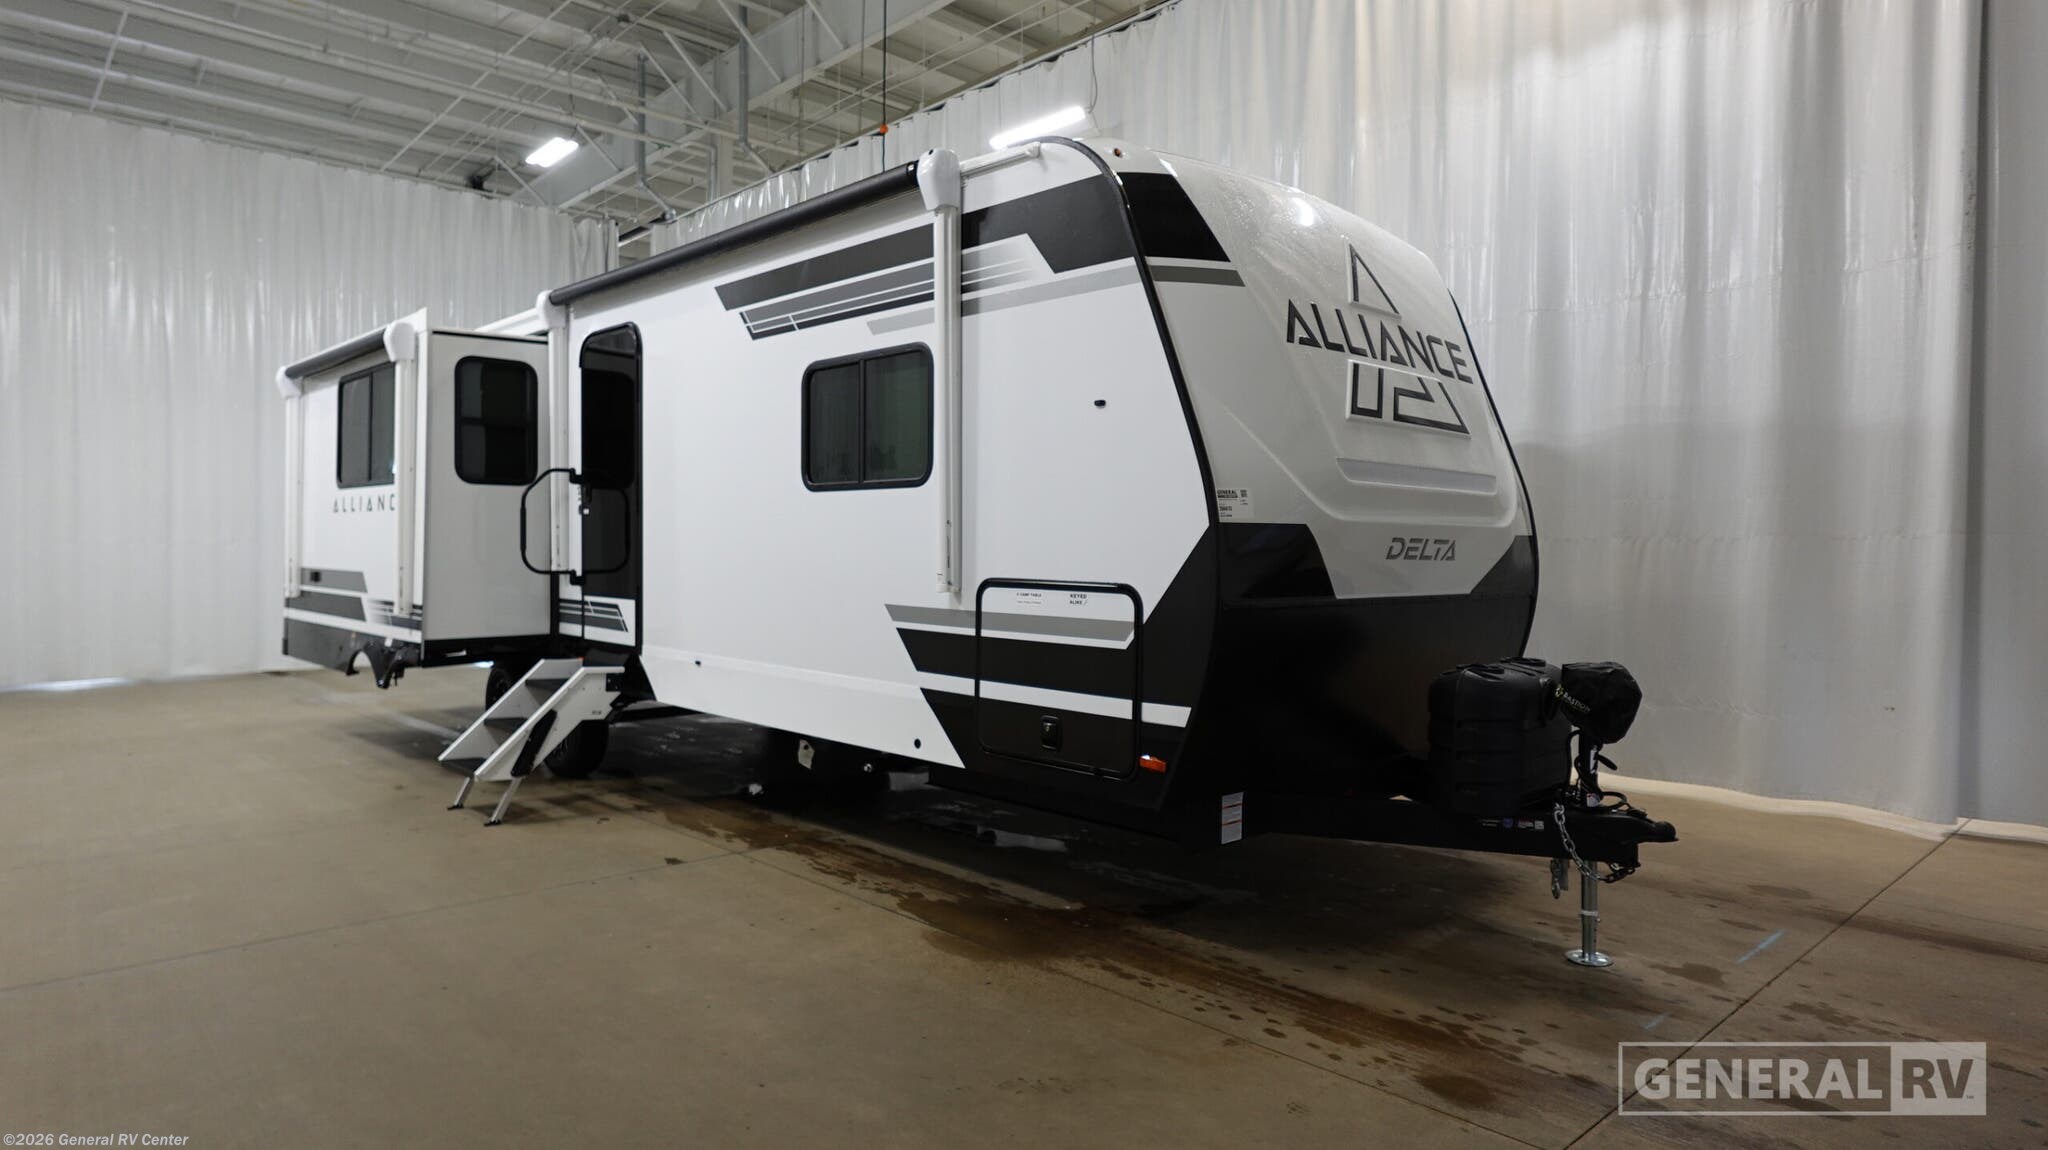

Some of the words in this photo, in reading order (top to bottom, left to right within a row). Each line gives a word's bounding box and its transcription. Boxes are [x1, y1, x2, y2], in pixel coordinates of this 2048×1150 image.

[1286, 298, 1474, 384] ALLIANCE
[333, 494, 396, 513] ALLIANC
[1385, 537, 1456, 561] DELTA
